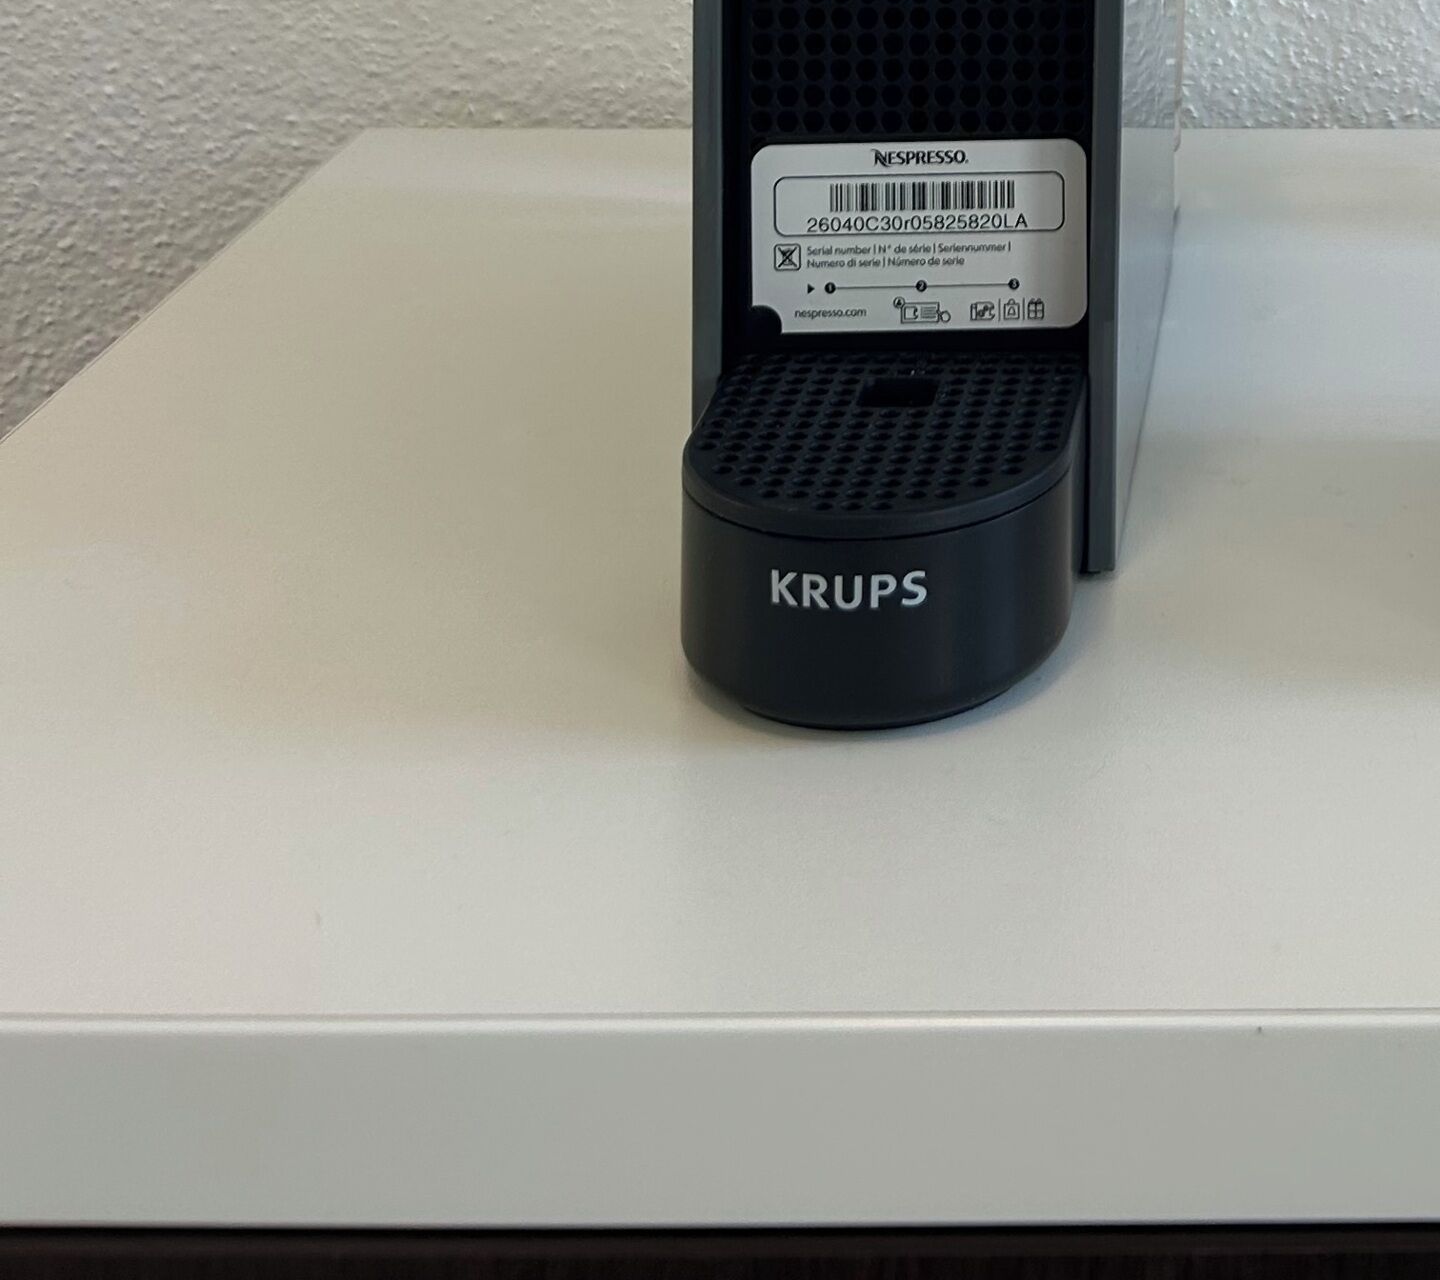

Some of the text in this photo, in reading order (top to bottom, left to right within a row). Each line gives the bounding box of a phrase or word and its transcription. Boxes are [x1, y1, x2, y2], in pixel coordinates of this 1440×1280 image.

[871, 148, 967, 168] NESPRESSO
[806, 212, 1028, 233] 26040C30r05825820LA
[807, 244, 833, 256] Serial
[834, 244, 871, 255] number
[894, 243, 907, 254] de
[938, 241, 1006, 253] Seriennummer
[807, 258, 846, 269] Numero
[847, 257, 857, 268] di
[859, 257, 881, 268] serie
[927, 256, 941, 266] de
[942, 255, 965, 266] serie
[794, 308, 867, 320] nespresso.com
[771, 568, 928, 610] KRUPS
